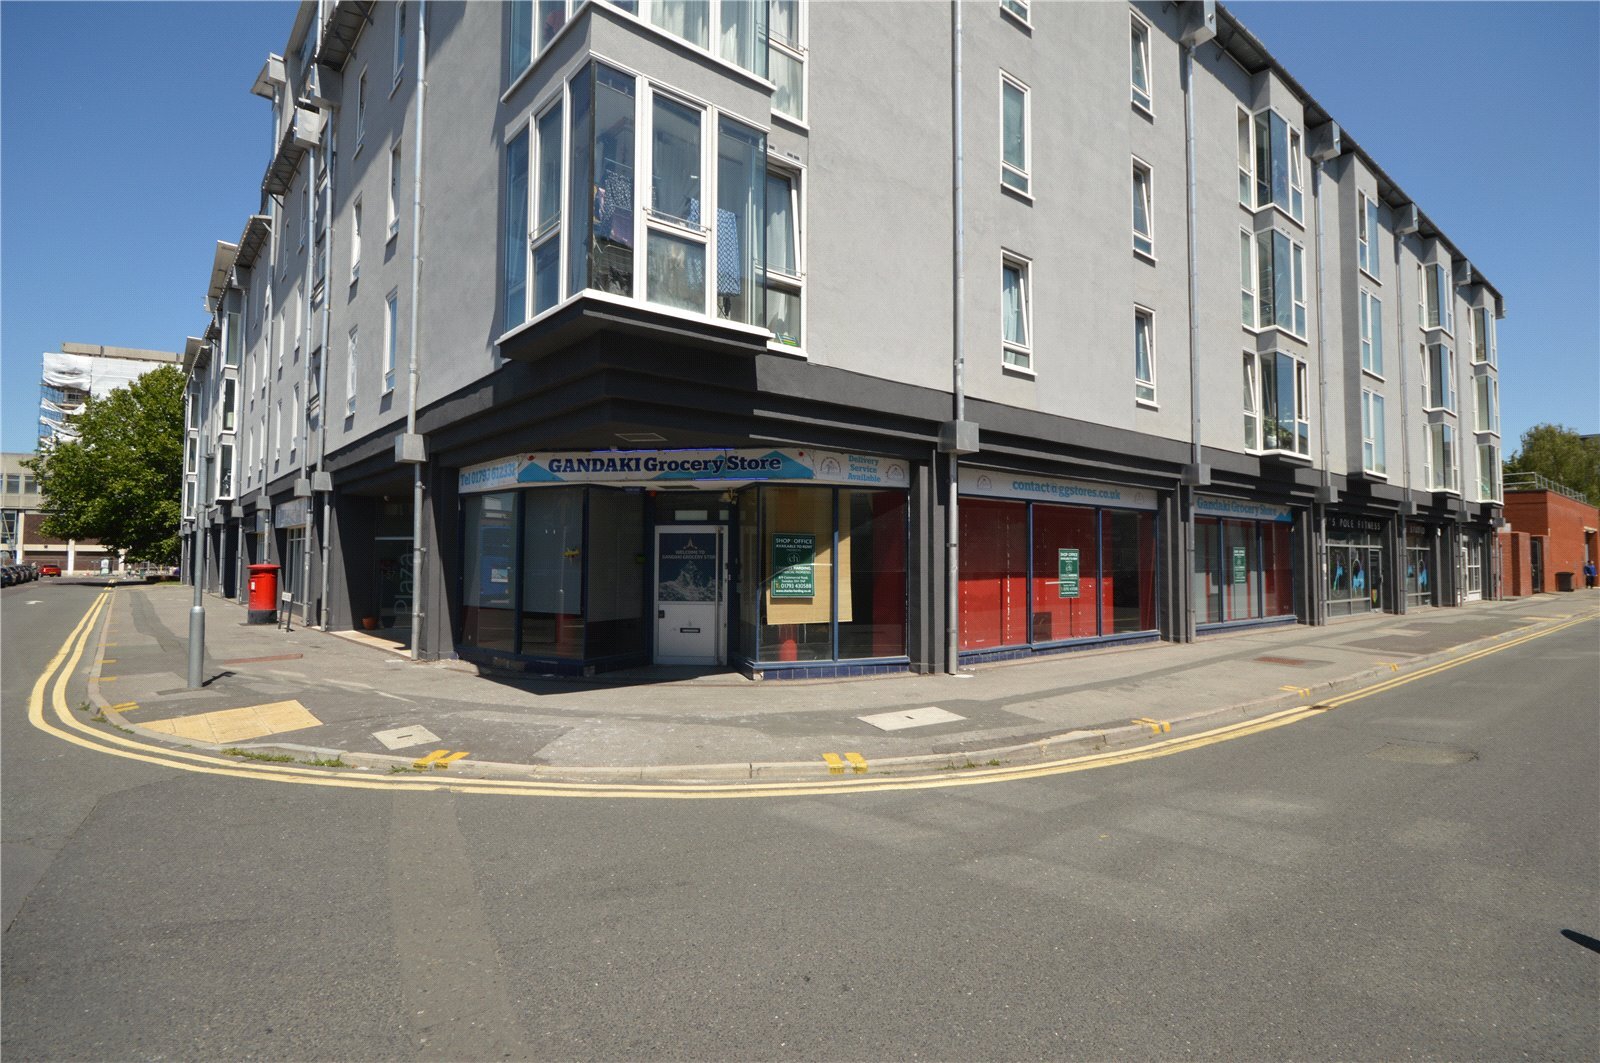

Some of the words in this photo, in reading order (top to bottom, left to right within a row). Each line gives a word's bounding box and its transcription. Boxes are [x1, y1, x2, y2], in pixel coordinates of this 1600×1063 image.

[548, 457, 641, 473] GANDAKI
[643, 456, 723, 474] Grocery
[726, 456, 781, 471] Store
[848, 455, 879, 466] Delivery
[850, 464, 878, 473] Service
[848, 473, 881, 483] Available
[1012, 480, 1121, 499] contact@ggstores.co.uk
[1231, 501, 1259, 516] Grocery
[1340, 519, 1354, 528] POLE
[1357, 520, 1381, 531] FITNESS
